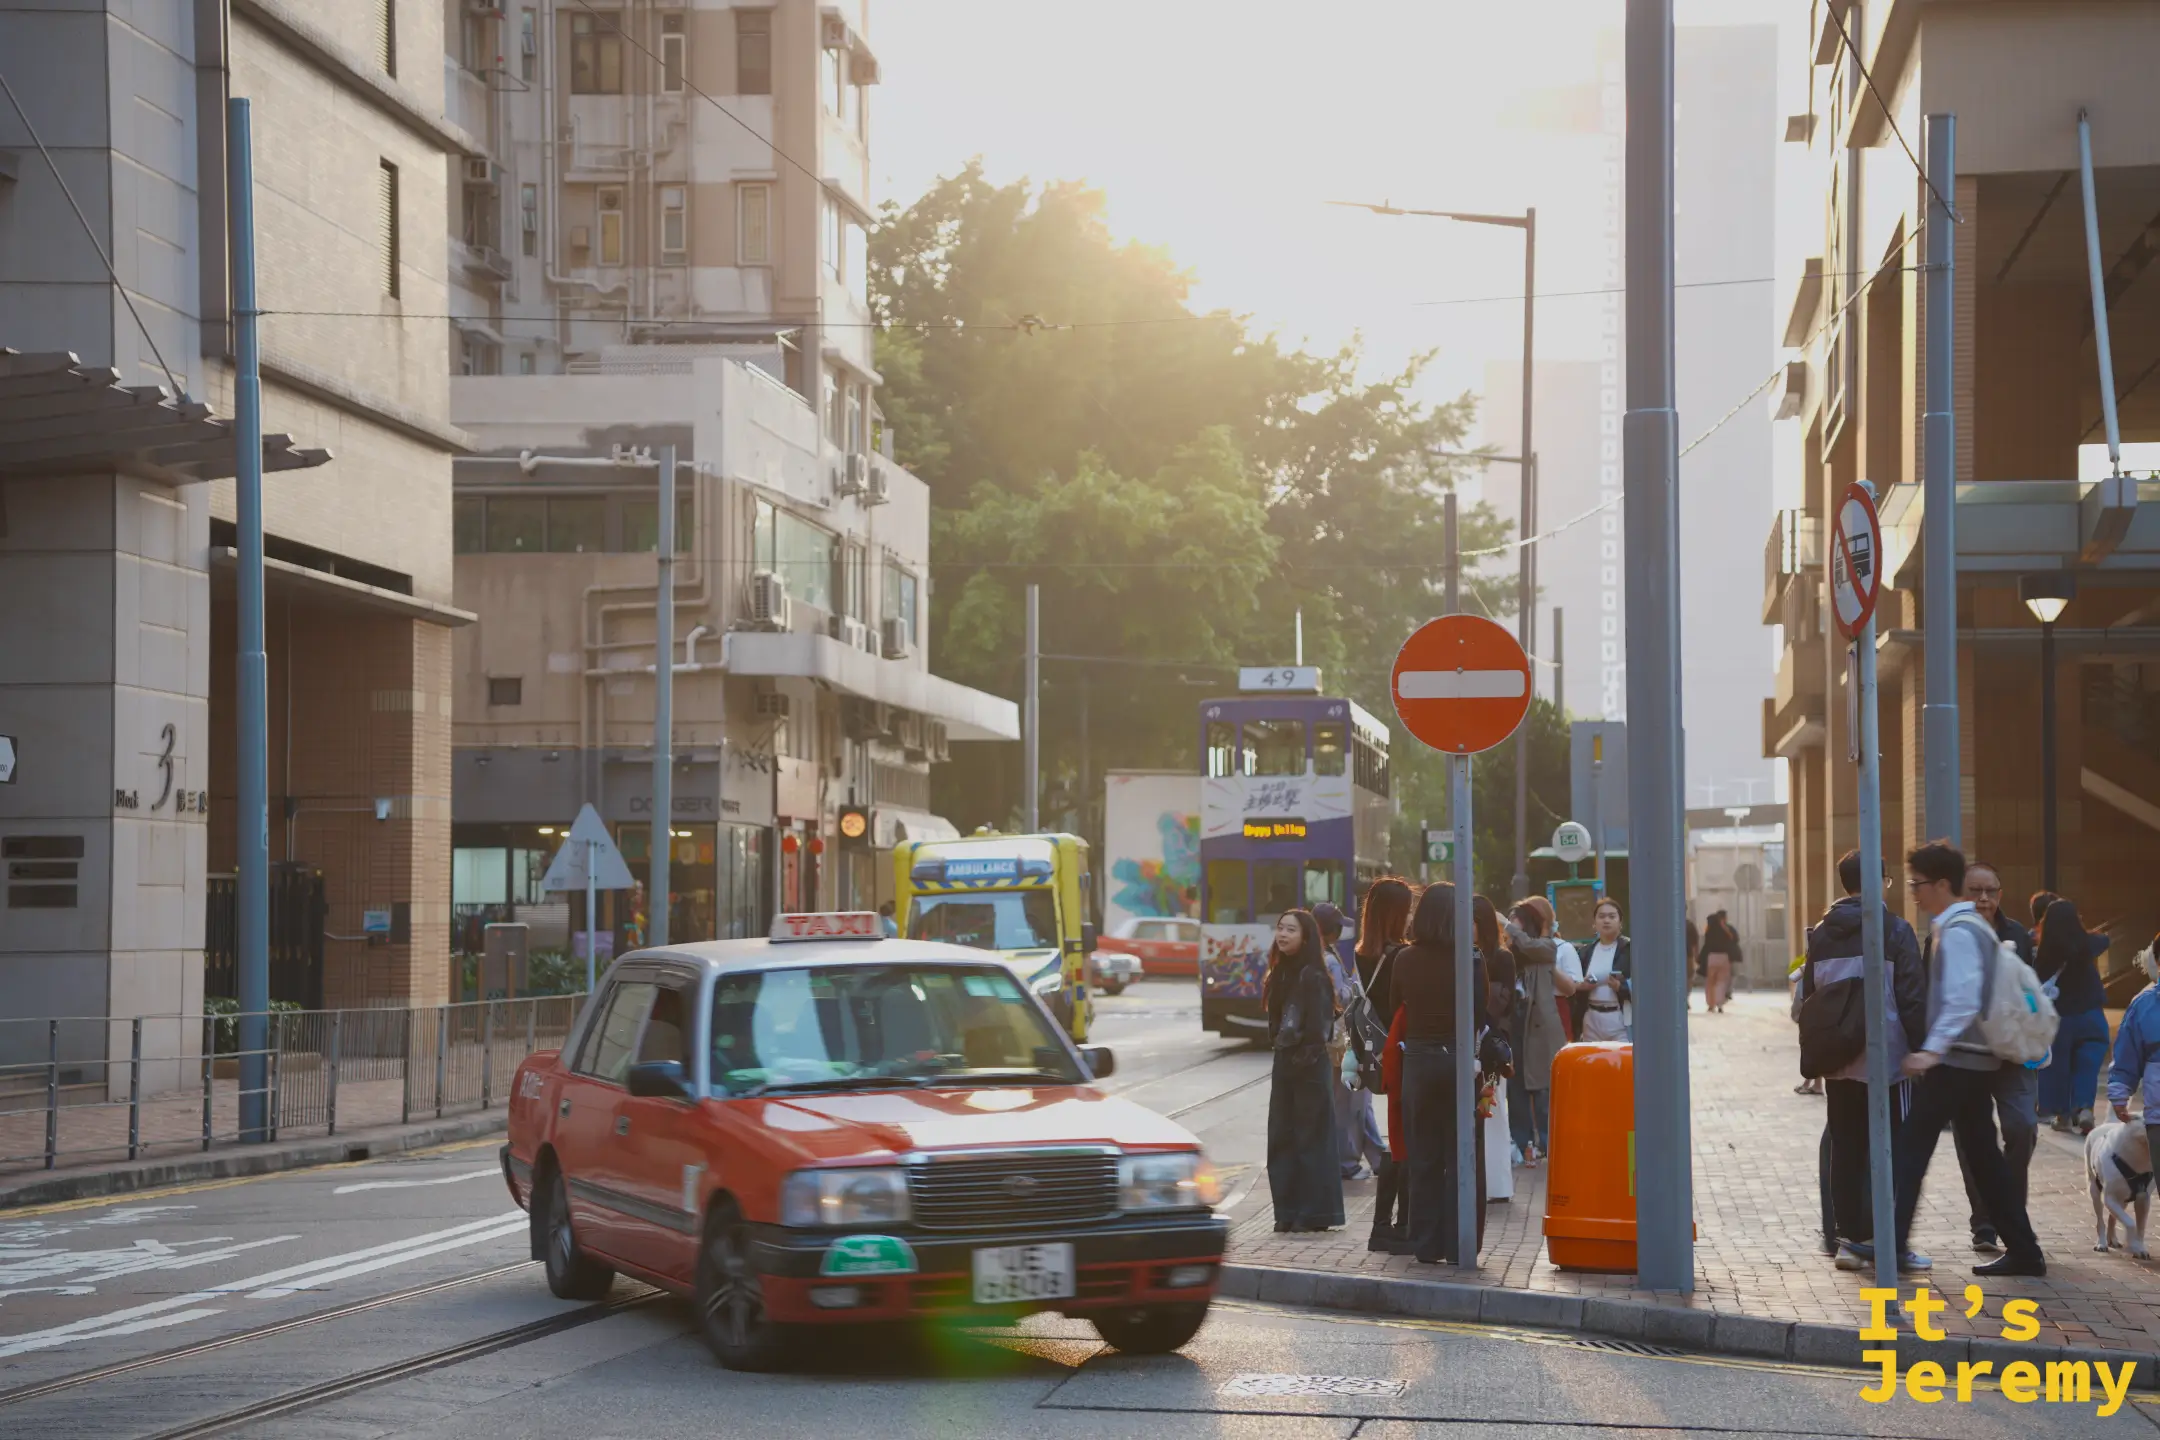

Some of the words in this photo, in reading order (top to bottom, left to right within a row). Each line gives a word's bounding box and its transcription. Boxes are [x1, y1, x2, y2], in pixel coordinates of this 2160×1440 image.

[1262, 670, 1295, 687] 49
[1206, 707, 1221, 718] 49
[1328, 705, 1342, 716] 49
[151, 723, 176, 811] 3
[947, 862, 1016, 876] AMBULANCE
[785, 915, 874, 936] TAXI
